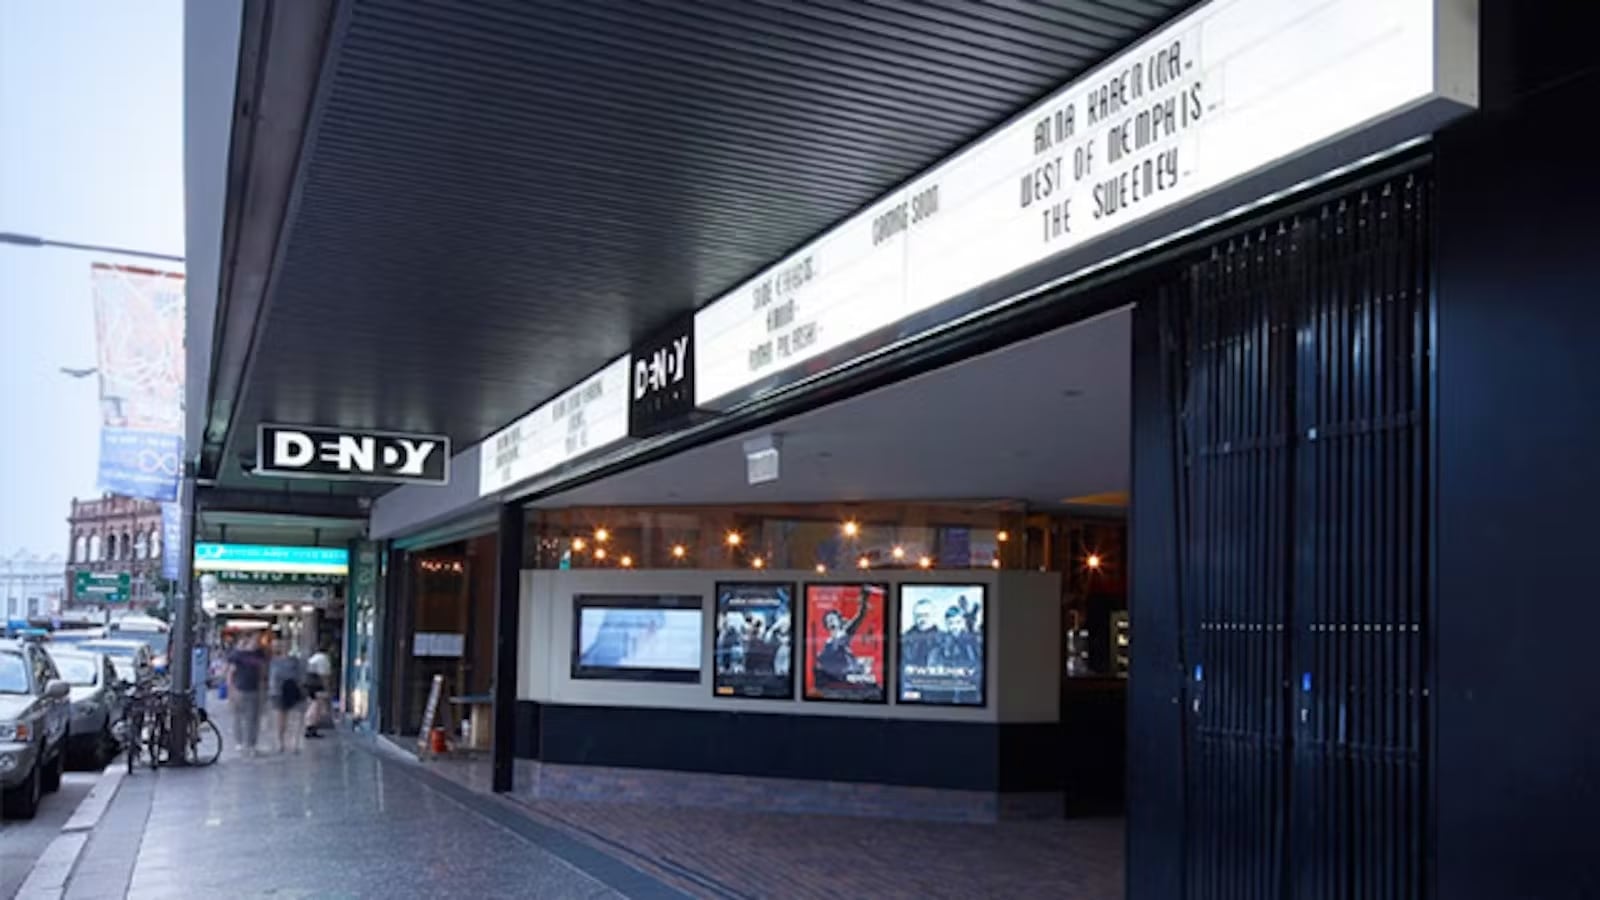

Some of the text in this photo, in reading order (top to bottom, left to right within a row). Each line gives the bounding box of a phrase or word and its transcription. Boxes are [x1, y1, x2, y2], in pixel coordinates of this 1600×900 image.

[1033, 40, 1181, 155] ANNA KARENINA
[1021, 81, 1202, 208] WEST OF MEMPHIS
[912, 184, 938, 224] SOON
[1043, 147, 1178, 242] THE SWEENEY
[634, 336, 689, 401] DENDY
[274, 431, 435, 475] DENDY
